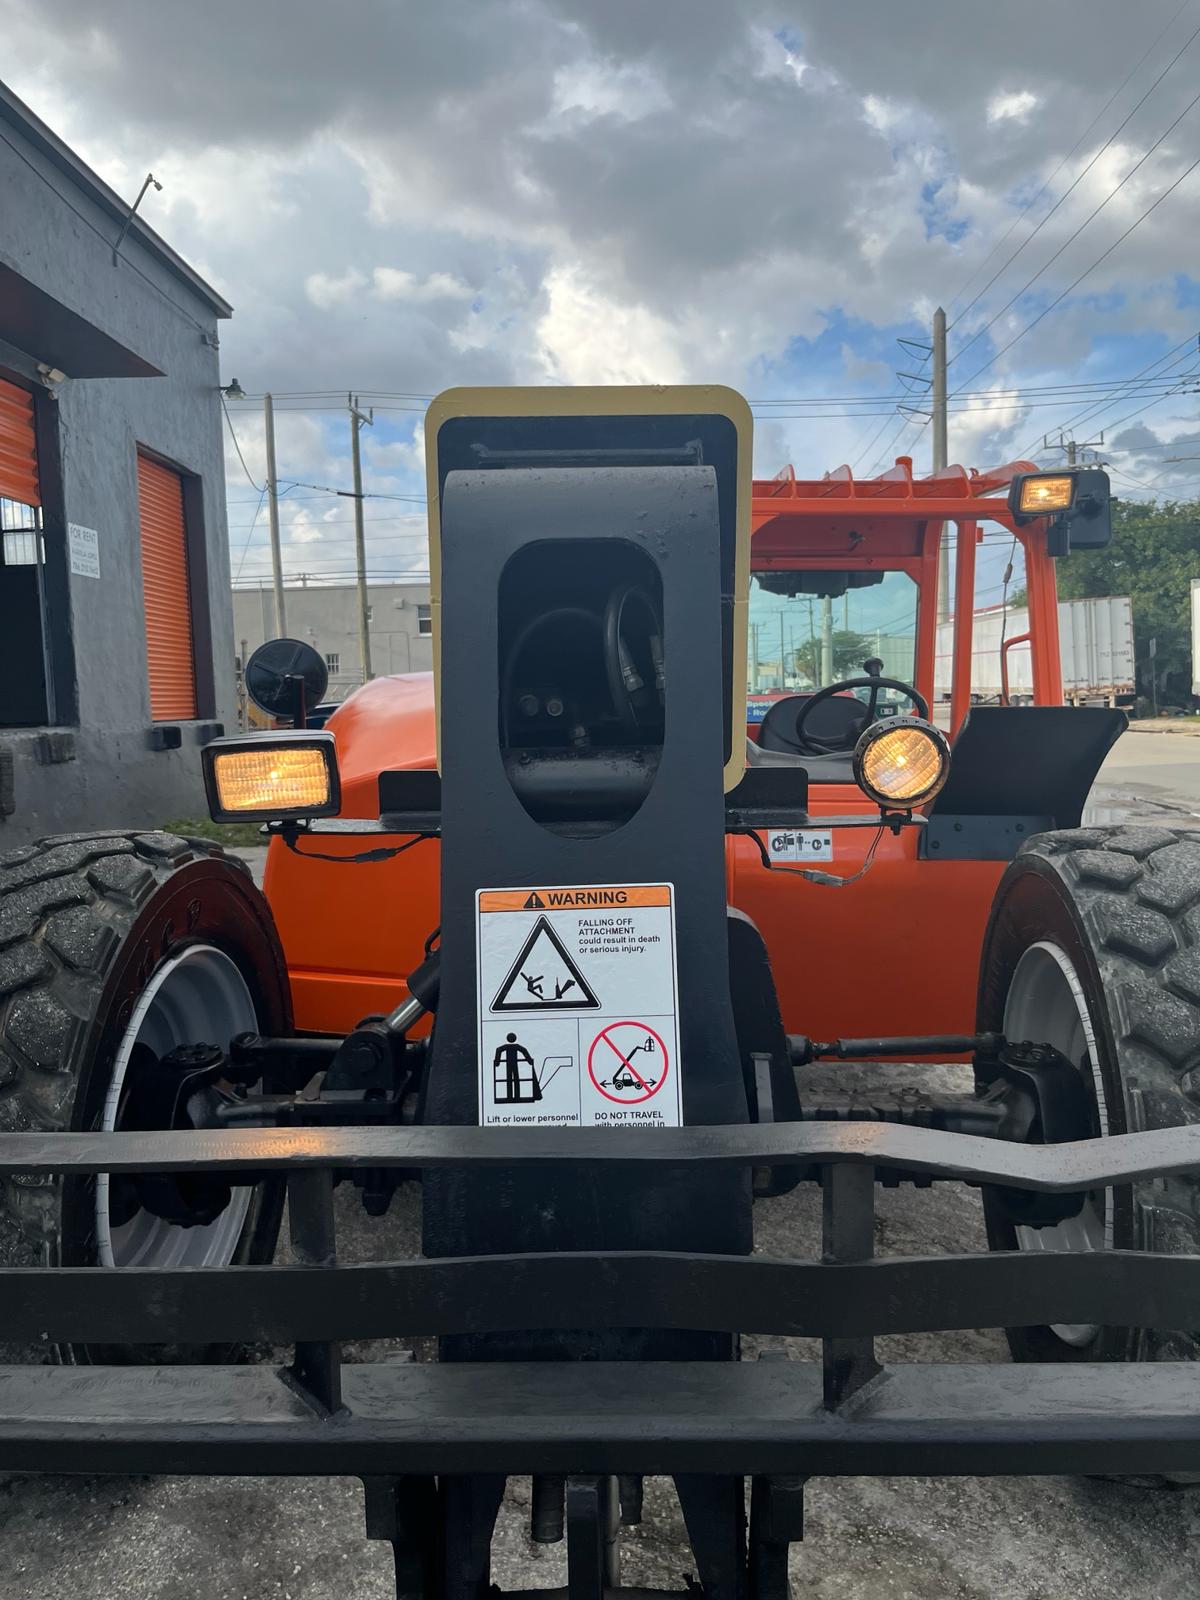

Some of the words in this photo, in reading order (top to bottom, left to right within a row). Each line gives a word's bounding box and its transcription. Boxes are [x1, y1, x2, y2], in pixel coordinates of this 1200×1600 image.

[70, 526, 81, 539] FOR
[83, 530, 97, 544] RENT
[548, 891, 627, 905] WARNING
[578, 918, 614, 927] FALLING
[616, 917, 633, 926] OFF
[578, 926, 636, 936] ATTACHMENT
[578, 936, 602, 945] could
[603, 935, 627, 944] result
[628, 935, 636, 943] in
[638, 934, 661, 943] death
[589, 945, 620, 954] serious
[621, 944, 647, 954] injury.
[487, 1115, 501, 1123] Lift
[502, 1115, 512, 1123] or
[513, 1114, 536, 1122] lower
[537, 1113, 579, 1123] personnel
[594, 1112, 608, 1120] DO
[609, 1111, 628, 1120] NOT
[630, 1110, 664, 1119] TRAVEL
